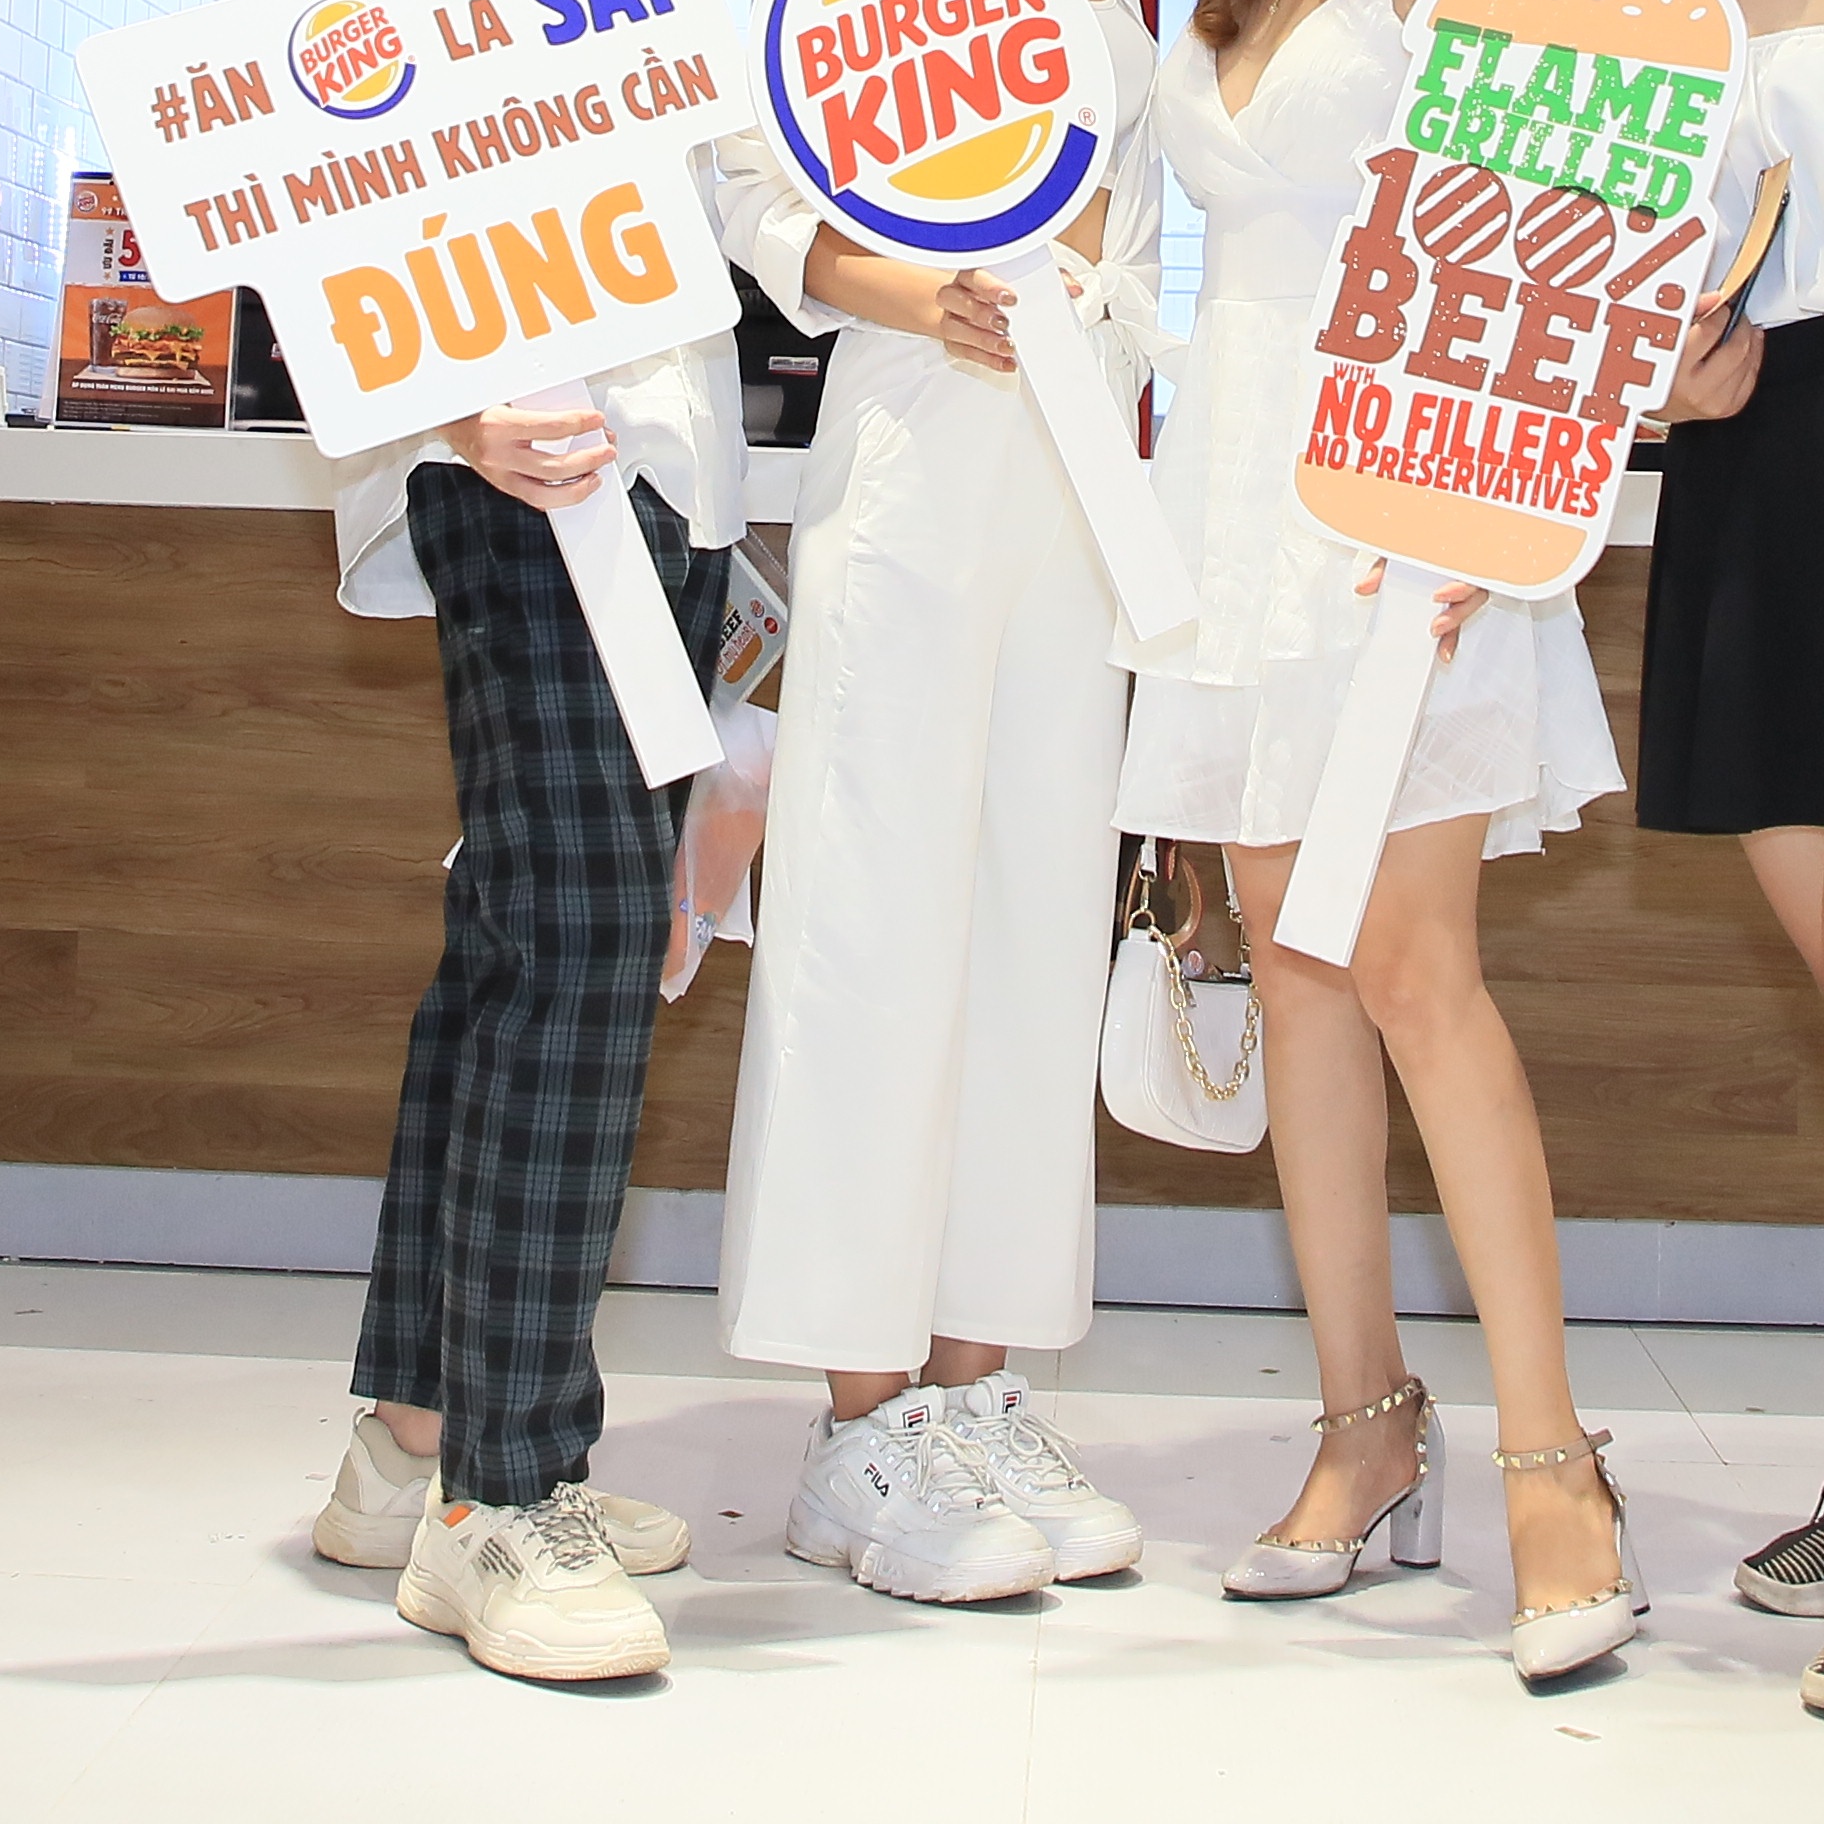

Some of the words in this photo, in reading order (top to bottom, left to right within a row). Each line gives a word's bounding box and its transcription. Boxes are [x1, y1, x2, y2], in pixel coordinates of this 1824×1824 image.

[298, 5, 389, 77] BURGER
[317, 23, 404, 107] KING
[1415, 17, 1725, 158] FLAME
[150, 60, 277, 143] #ĂN
[184, 174, 278, 252] THÌ
[284, 150, 428, 224] MÌNH
[432, 84, 615, 180] KHÔNG
[620, 47, 719, 121] CẦN
[822, 17, 1071, 188] KING
[1406, 95, 1691, 220] GRILLED
[321, 181, 679, 393] ĐÚNG
[1363, 148, 1707, 312] 100%
[1314, 225, 1683, 428] BEEF
[1332, 361, 1376, 384] WITH
[1304, 432, 1351, 471] NO
[1355, 438, 1605, 519] PRESERVATIVES
[1312, 376, 1393, 442] NO
[1402, 391, 1623, 488] FILLERS
[863, 1462, 890, 1498] FILA
